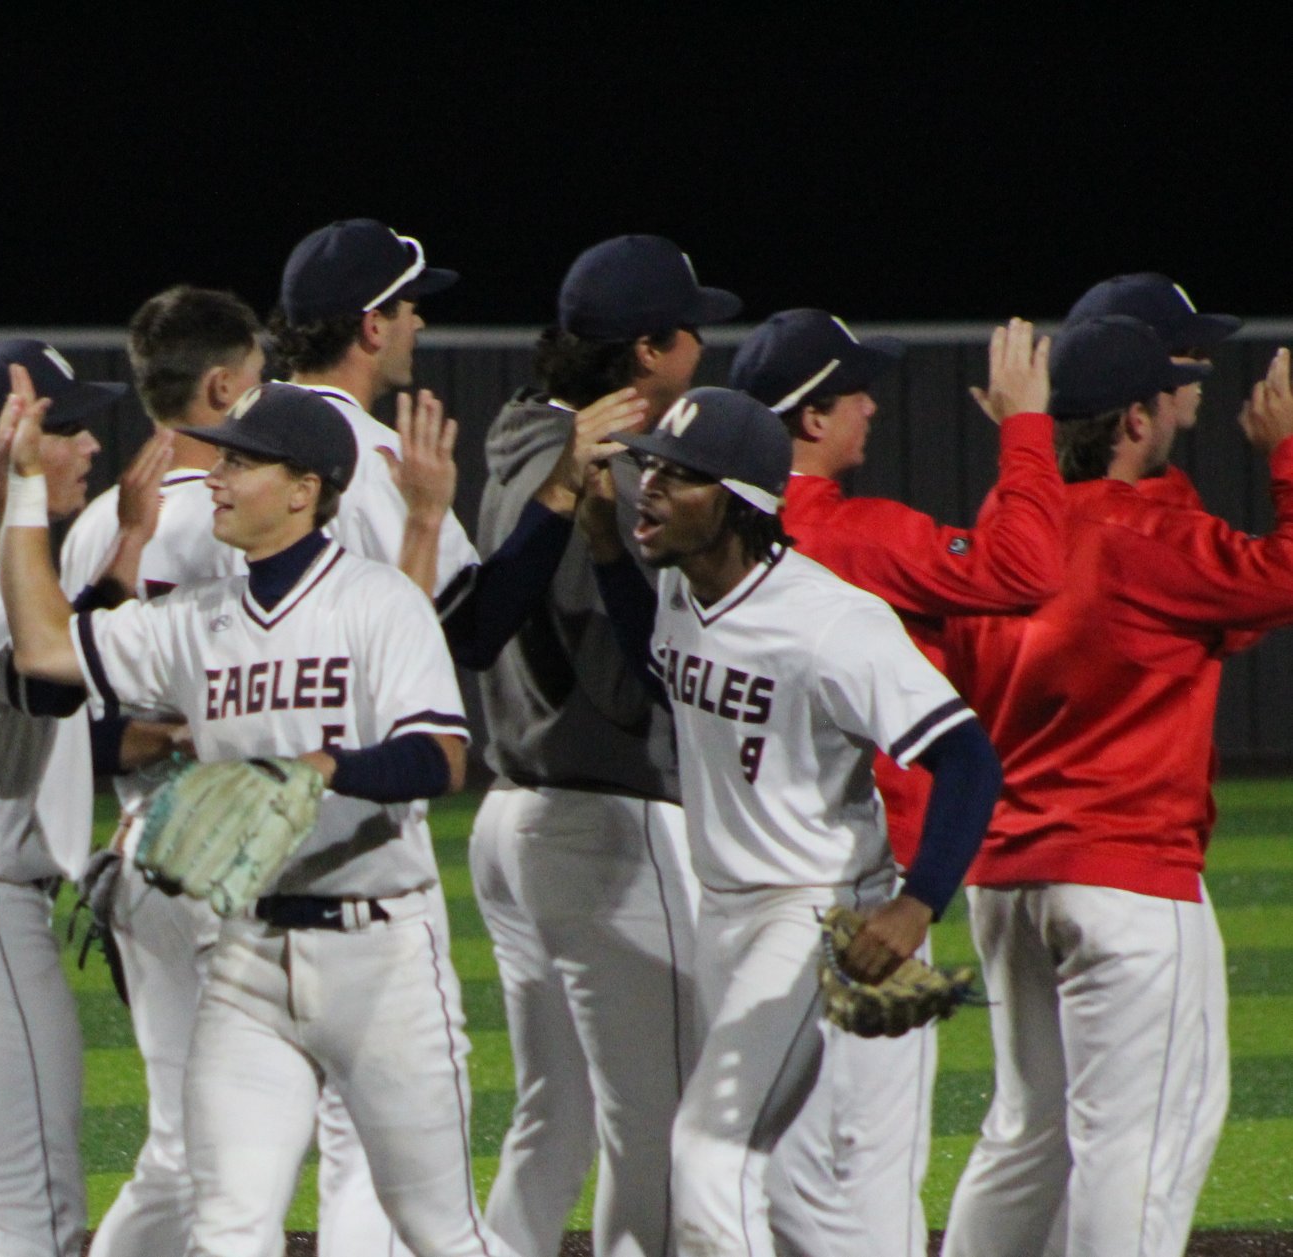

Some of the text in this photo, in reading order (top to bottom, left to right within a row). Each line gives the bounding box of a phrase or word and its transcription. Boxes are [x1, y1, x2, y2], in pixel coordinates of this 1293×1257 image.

[226, 386, 262, 420] N
[658, 397, 698, 438] N
[205, 657, 350, 721] EAGLES
[740, 736, 766, 785] 9
